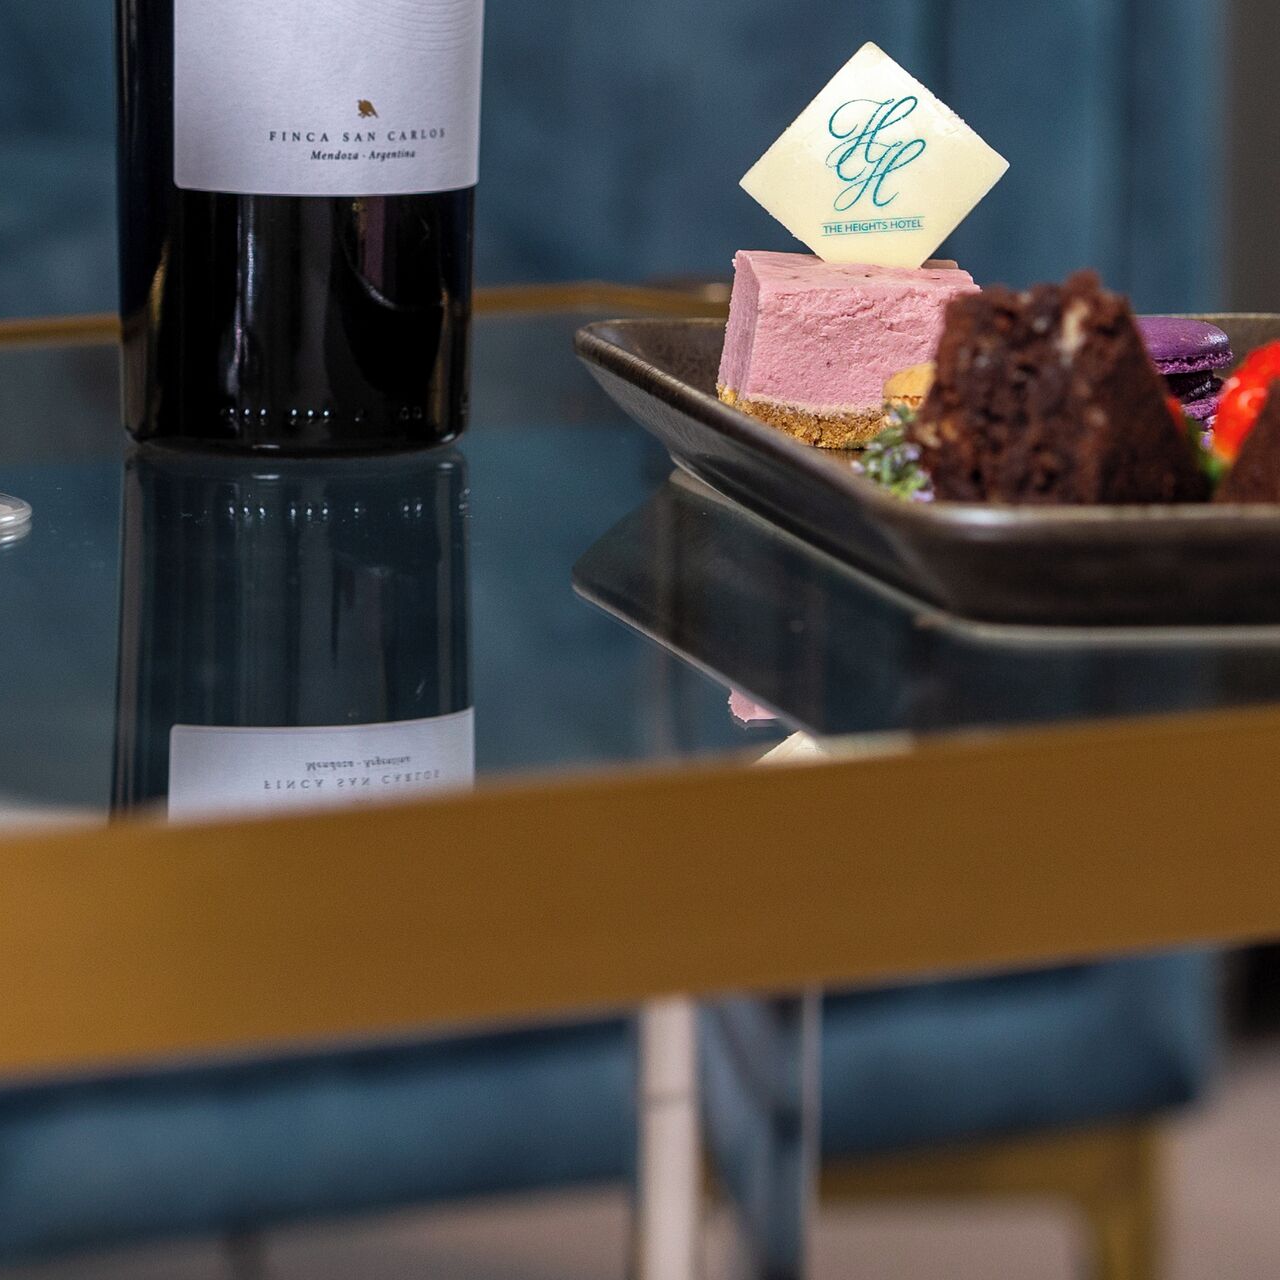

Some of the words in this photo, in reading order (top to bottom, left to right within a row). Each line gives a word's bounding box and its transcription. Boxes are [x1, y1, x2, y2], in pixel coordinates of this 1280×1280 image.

[269, 131, 329, 143] FINCA
[342, 132, 376, 142] SAN
[387, 128, 446, 142] CARLOS
[310, 150, 359, 161] Mendoza
[369, 149, 416, 163] Argentina
[823, 224, 843, 234] THE
[845, 221, 888, 232] HEIGHTS
[890, 219, 923, 229] HOTEL
